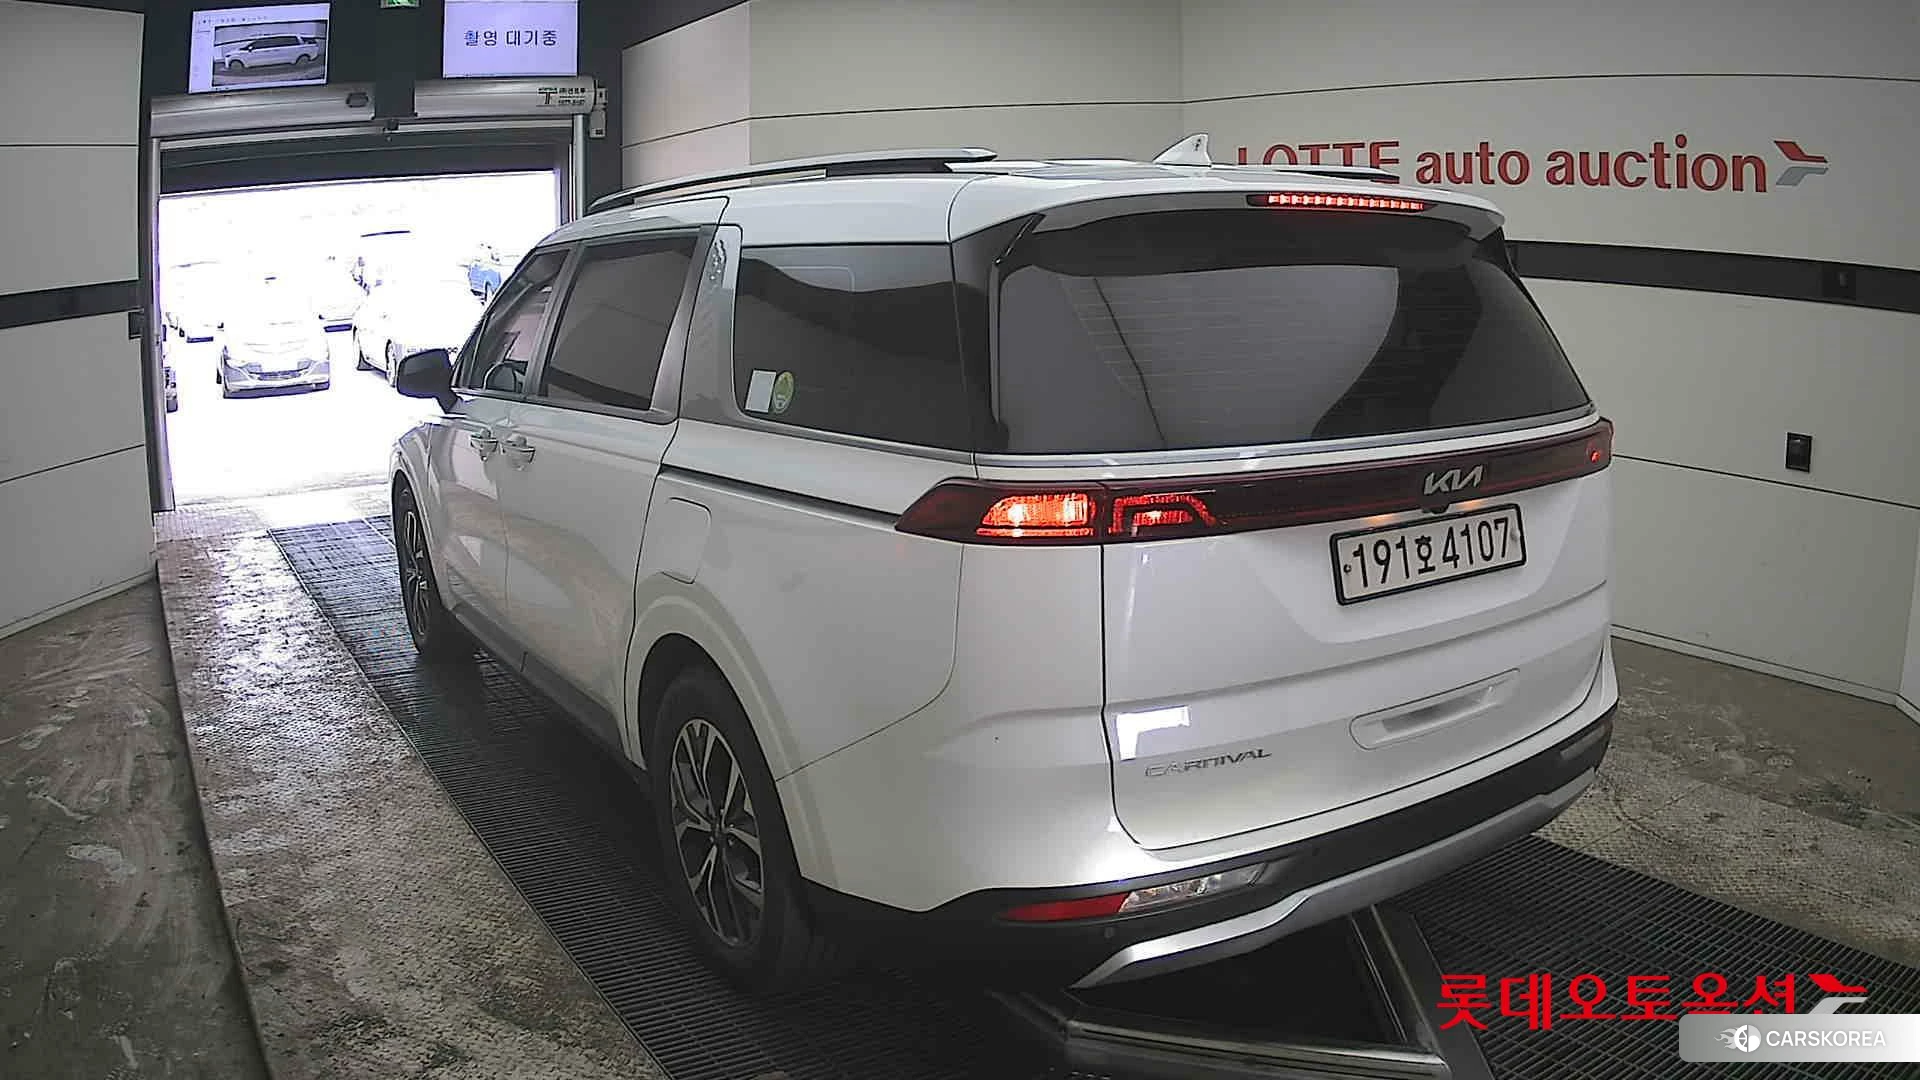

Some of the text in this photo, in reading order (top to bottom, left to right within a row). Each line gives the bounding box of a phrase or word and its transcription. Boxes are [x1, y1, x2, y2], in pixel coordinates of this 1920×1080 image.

[463, 29, 557, 47] 촬영 대기중
[1415, 141, 1530, 186] auto
[1546, 134, 1768, 193] auction
[1423, 464, 1484, 495] KIA
[1352, 517, 1509, 588] 191호4107
[1144, 748, 1273, 777] CARNIVAL
